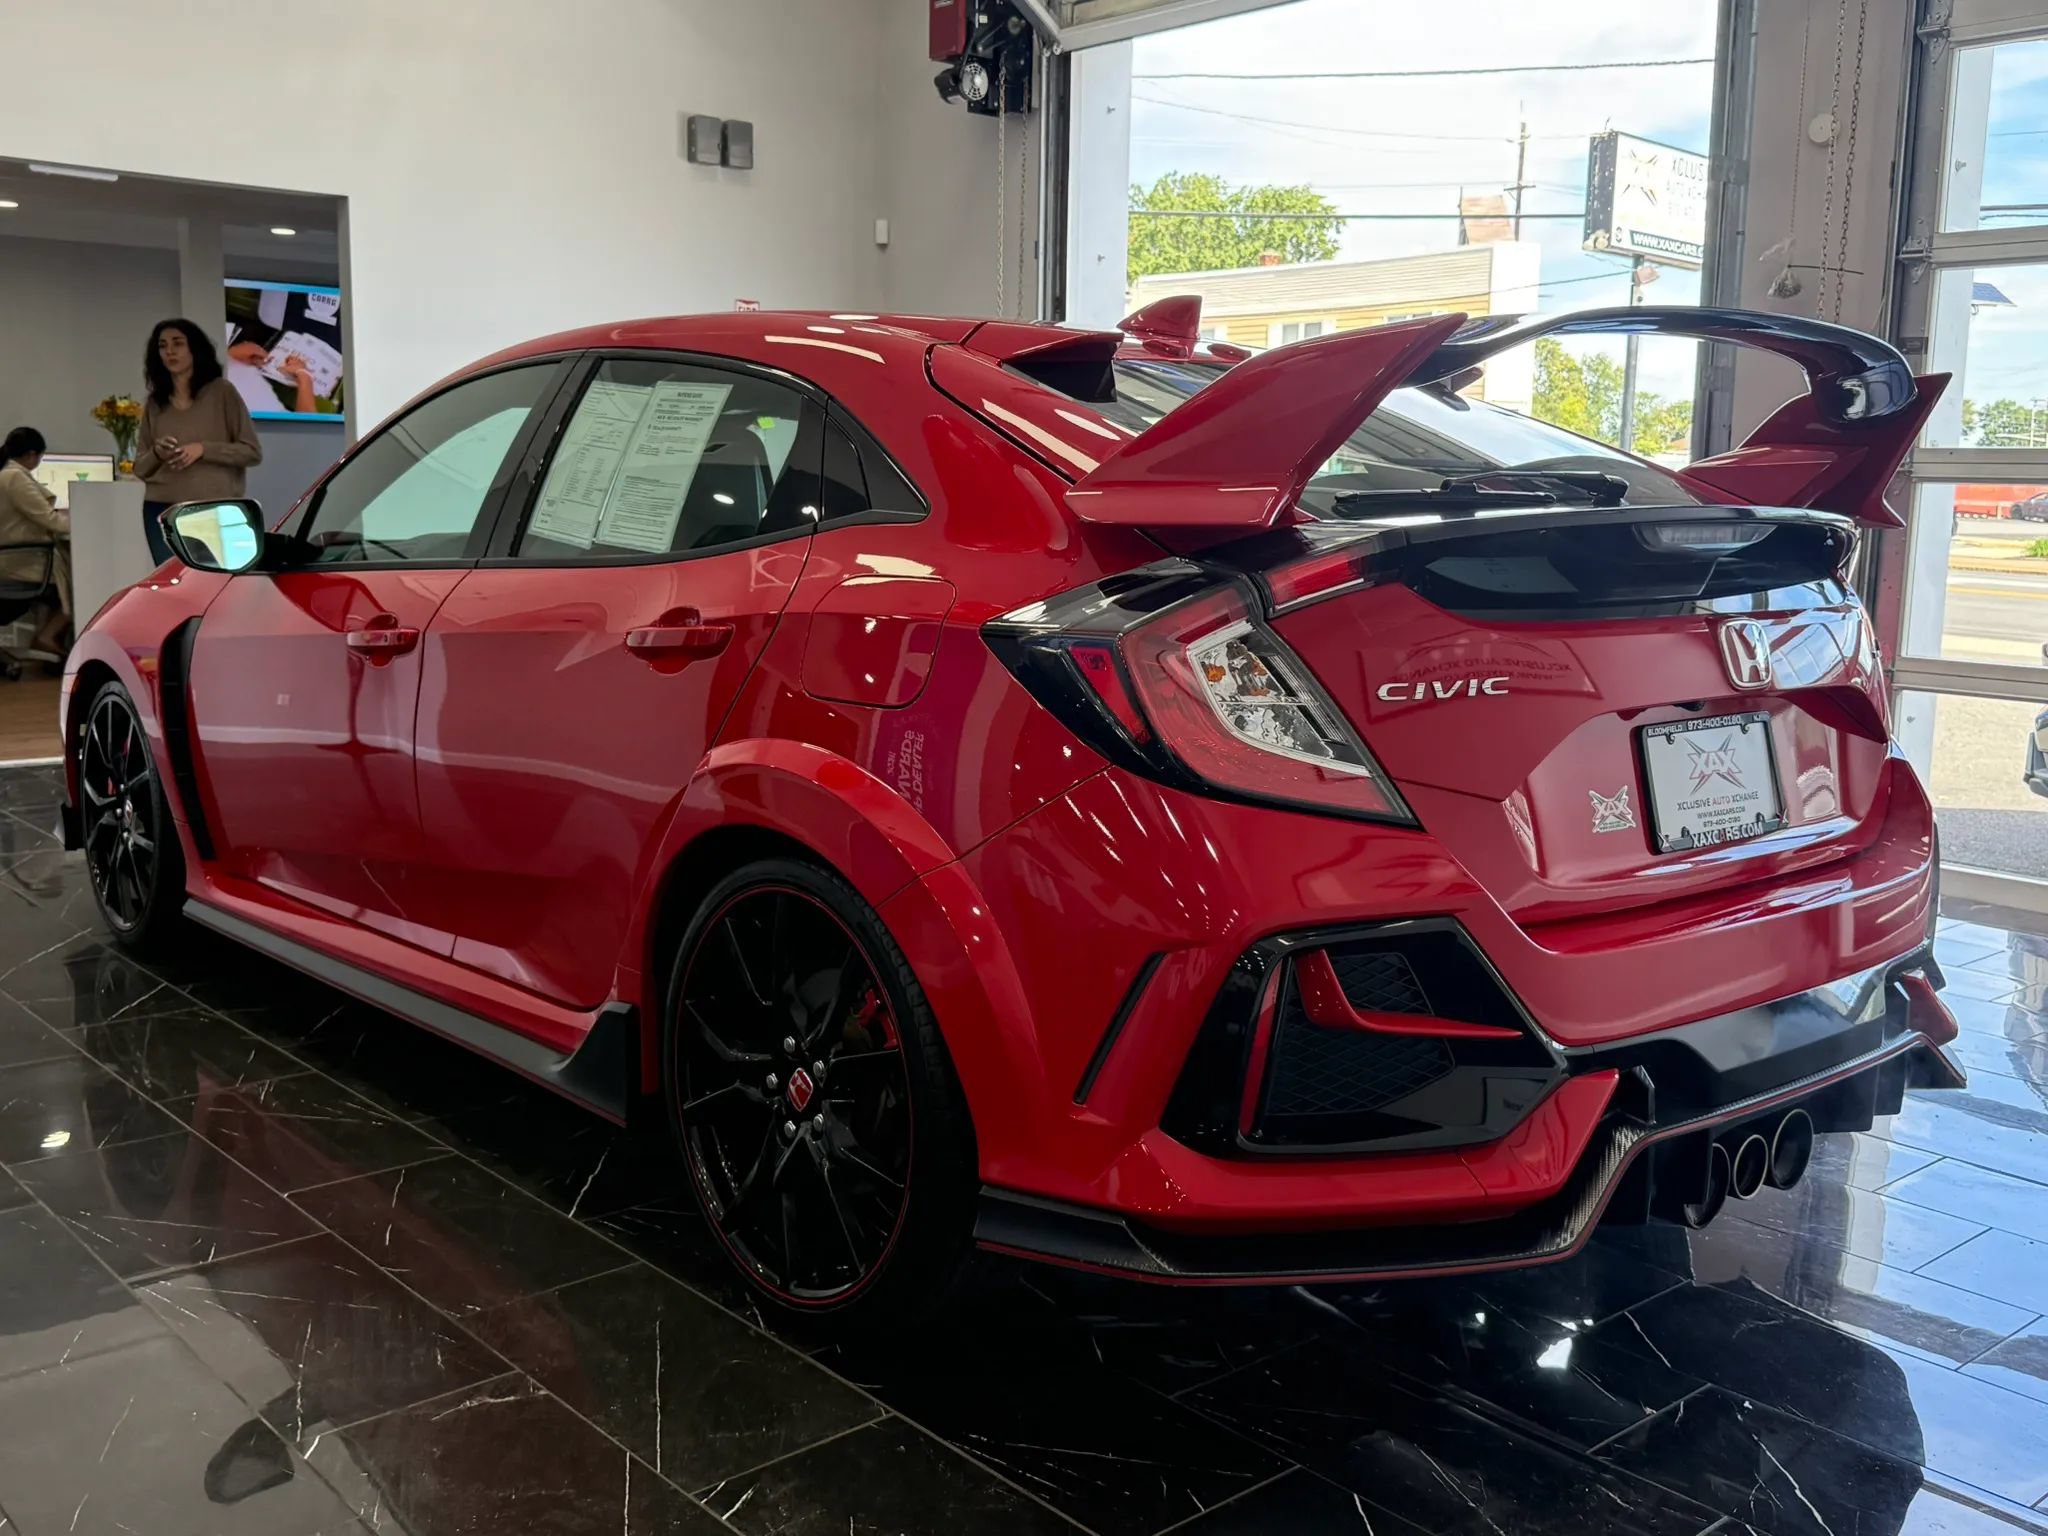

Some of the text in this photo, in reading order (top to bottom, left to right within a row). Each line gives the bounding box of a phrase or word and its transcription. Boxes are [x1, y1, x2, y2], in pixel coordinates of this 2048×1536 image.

[1376, 677, 1510, 701] CIVIC
[1648, 724, 1683, 737] BLOOMFIELD
[1688, 748, 1742, 780] XAX
[1592, 798, 1632, 821] XAX
[1677, 797, 1711, 812] XCLUSIVE
[1712, 794, 1731, 807] AUTO
[1692, 821, 1763, 848] XAXCARS.COM
